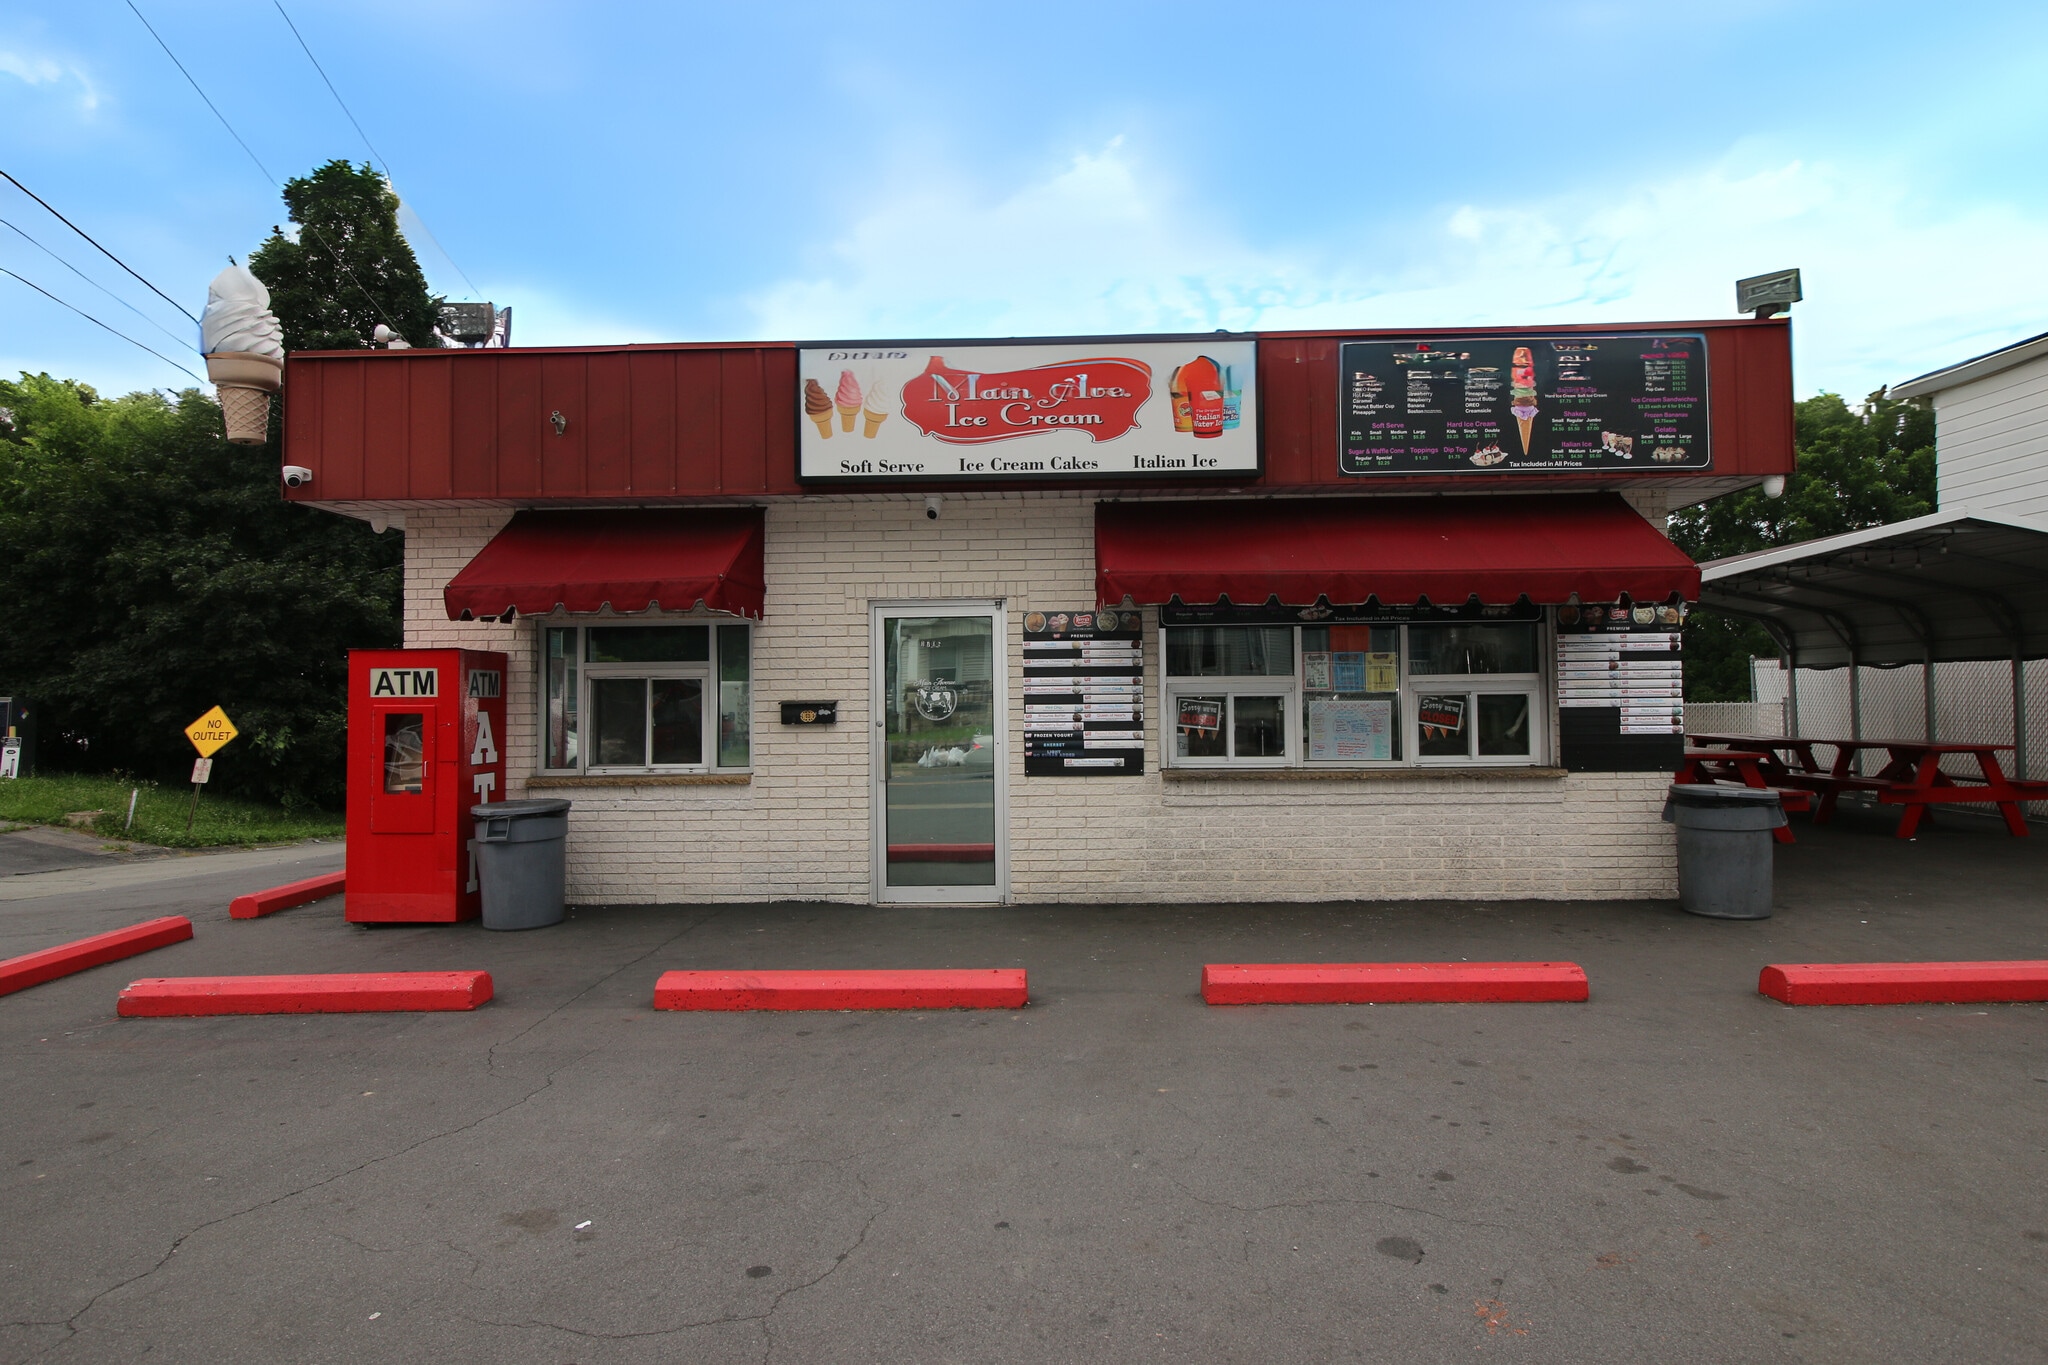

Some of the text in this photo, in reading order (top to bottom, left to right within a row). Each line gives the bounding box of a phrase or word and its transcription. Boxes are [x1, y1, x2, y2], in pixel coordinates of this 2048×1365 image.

[928, 373, 1132, 408] Main Ave.
[944, 402, 1104, 427] Ice Cream
[840, 459, 924, 474] Soft Serve
[959, 456, 1098, 472] Ice Cream Cakes
[1133, 454, 1218, 468] Italian Ice
[374, 670, 435, 696] ATM
[469, 672, 499, 696] ATM
[1182, 702, 1201, 713] Sorry
[1422, 700, 1443, 711] Sorry
[208, 720, 222, 728] NO
[1181, 713, 1217, 726] CLOSED
[1421, 710, 1458, 726] CLOSED
[193, 732, 231, 740] OUTLET
